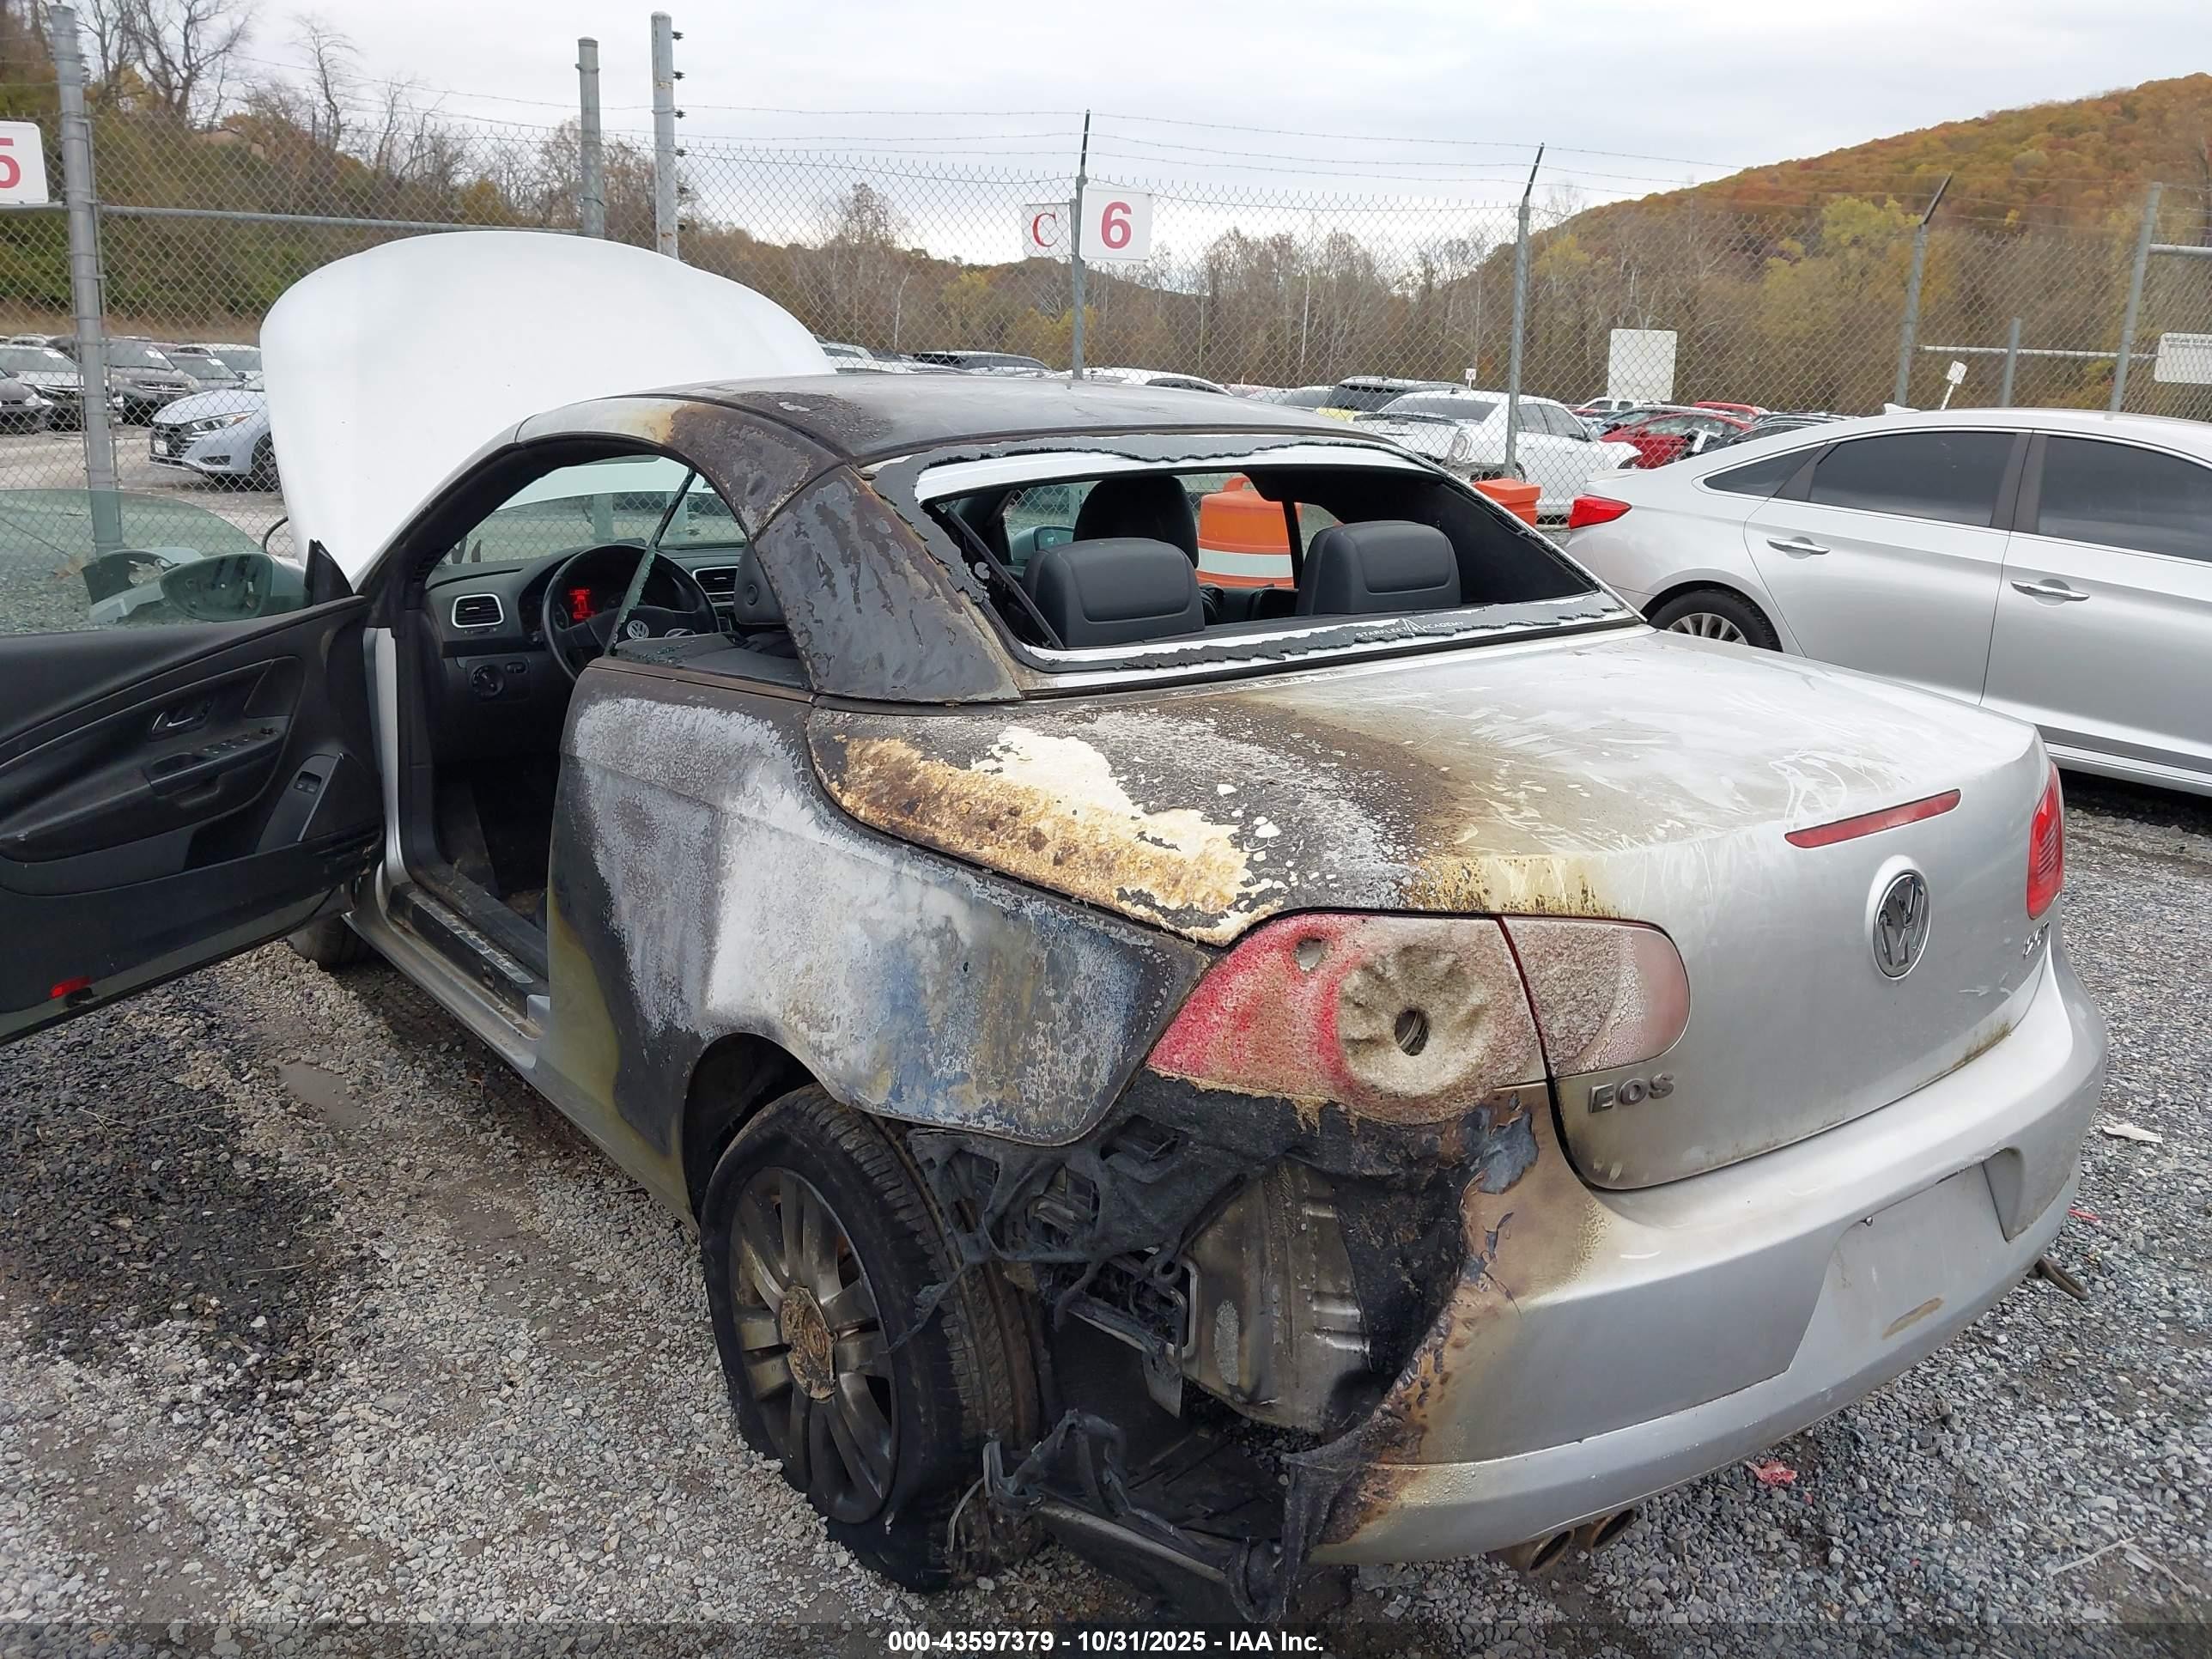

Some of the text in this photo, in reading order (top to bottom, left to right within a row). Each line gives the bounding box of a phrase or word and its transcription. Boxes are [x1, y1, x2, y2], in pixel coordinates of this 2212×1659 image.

[0, 137, 21, 189] 5
[1032, 212, 1058, 247] C
[1101, 201, 1132, 249] 6
[1355, 621, 1464, 638] STARFLEET ACADEMY
[1588, 1073, 1674, 1114] EOS
